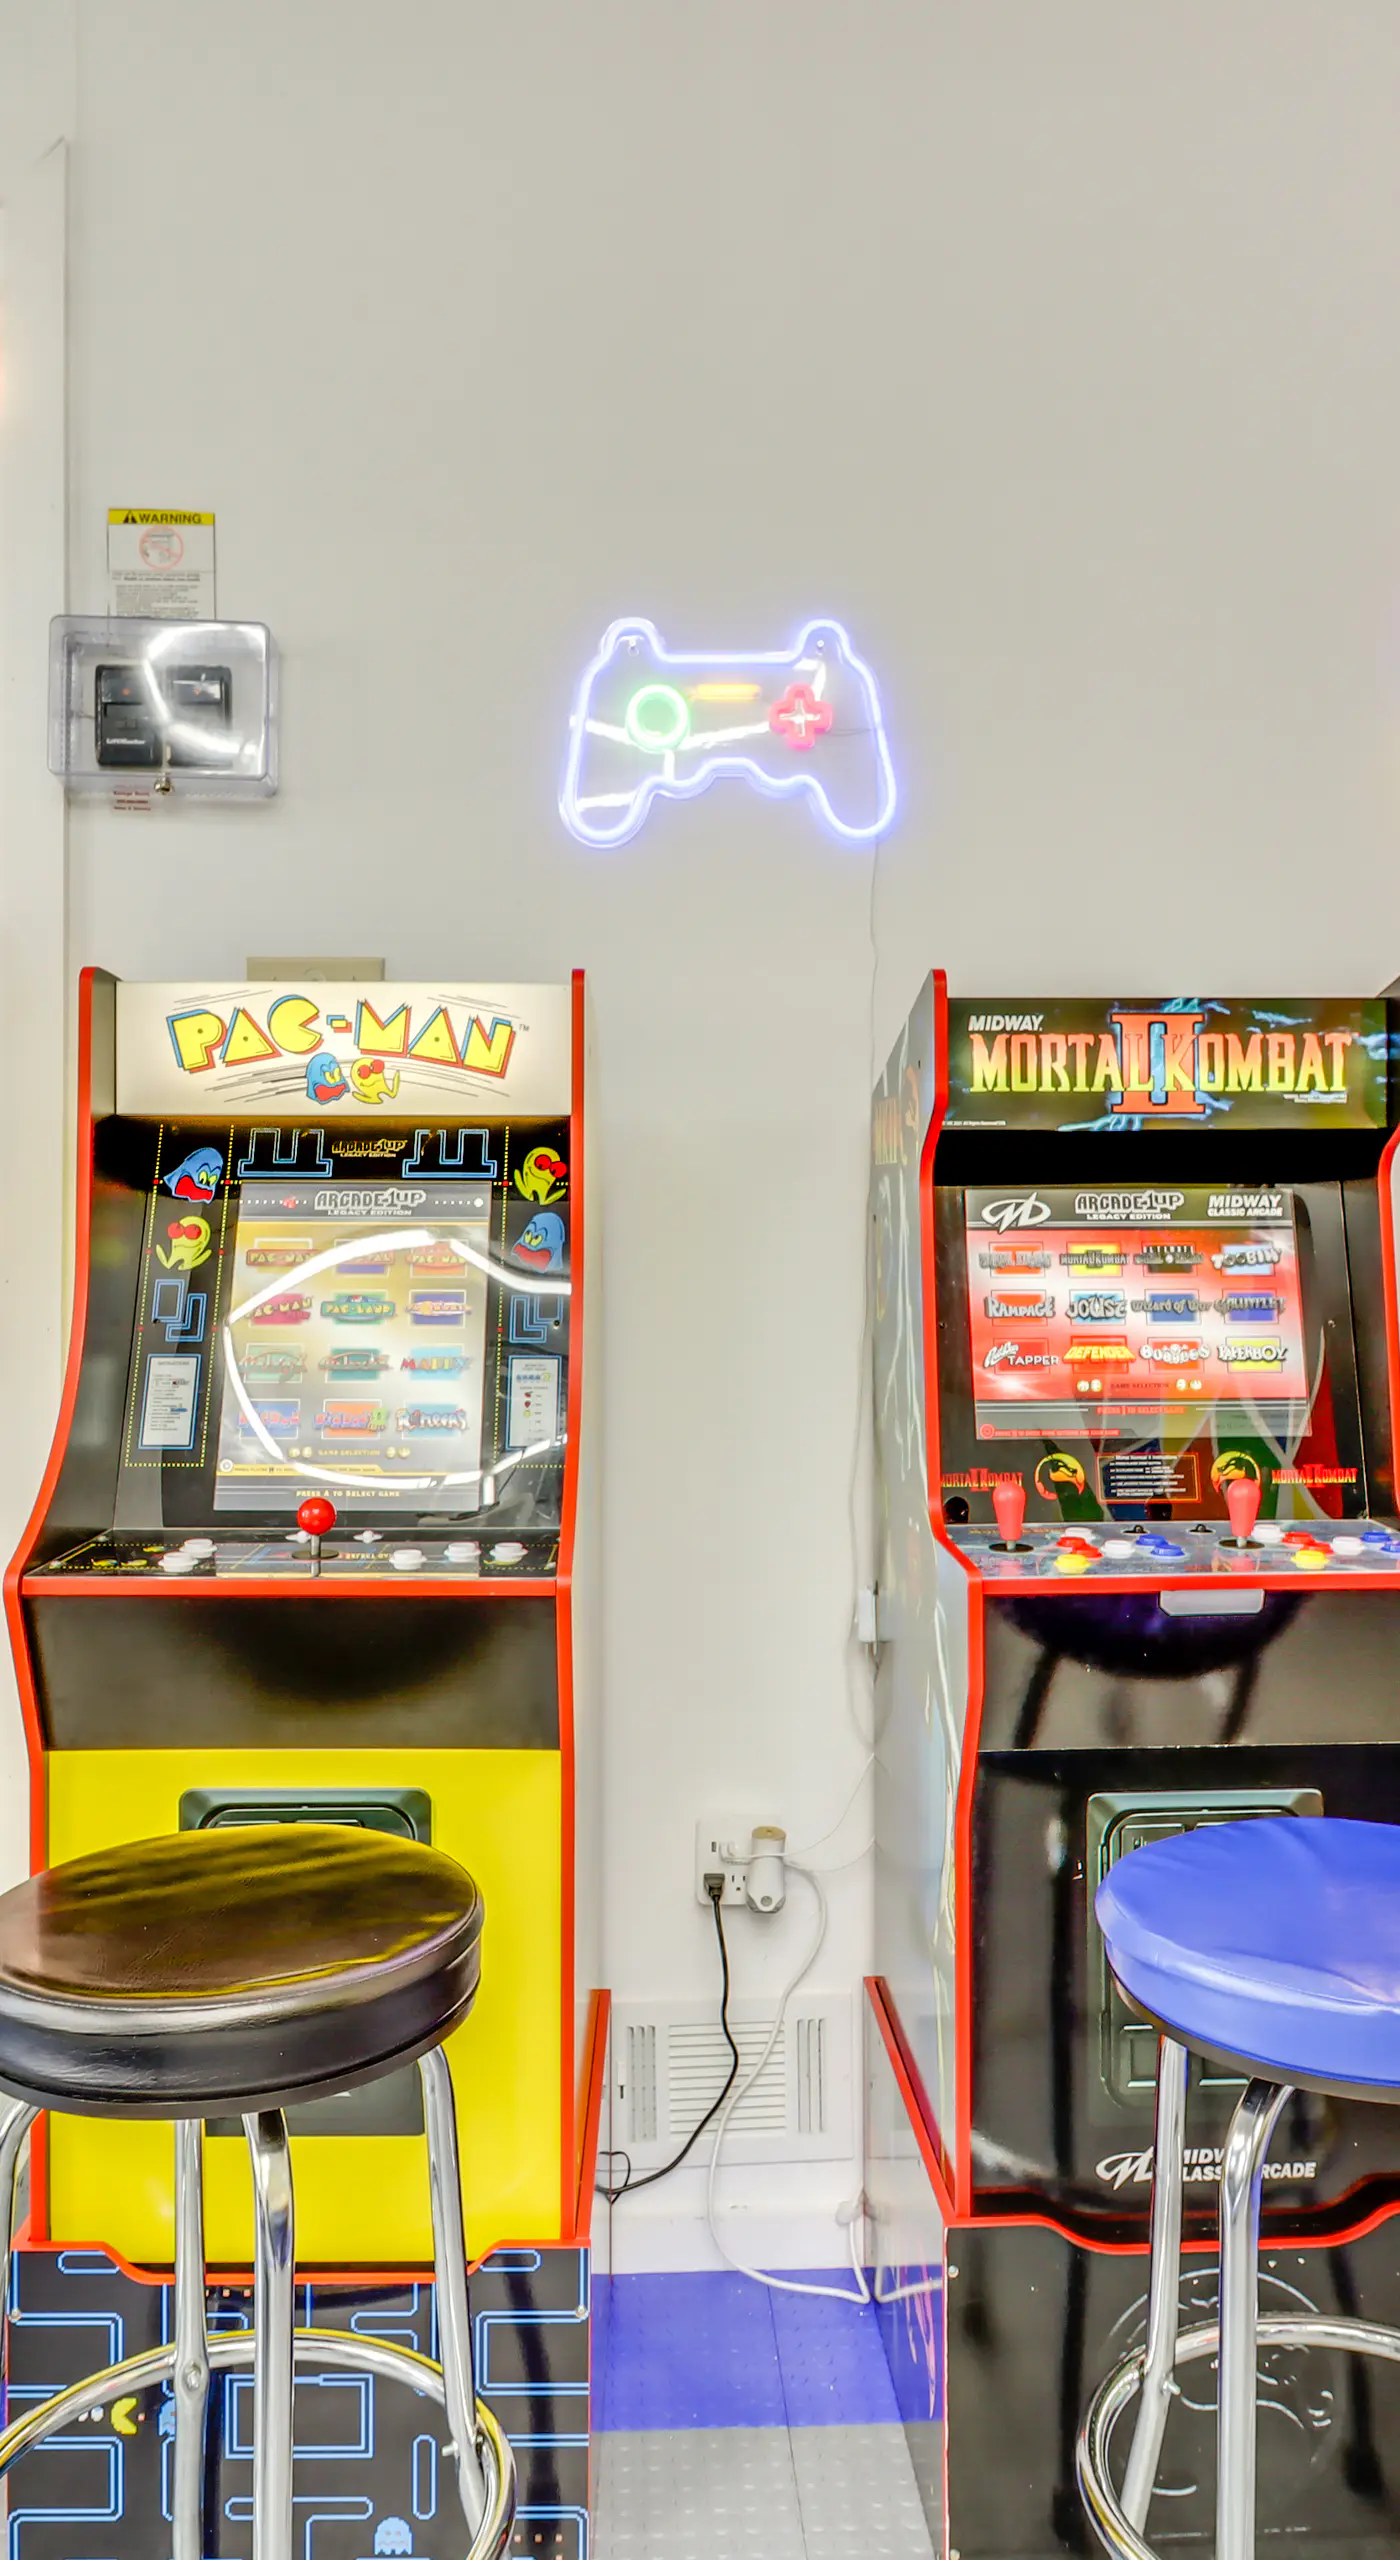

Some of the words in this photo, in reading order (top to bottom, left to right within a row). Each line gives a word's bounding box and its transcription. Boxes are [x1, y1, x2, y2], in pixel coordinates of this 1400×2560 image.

[139, 513, 202, 524] WARNING
[165, 994, 517, 1078] PAC-MAN
[969, 1033, 1155, 1093] MORTAL
[1162, 1033, 1354, 1093] KOMBAT
[1208, 1194, 1282, 1208] MIDWAY
[1086, 1213, 1127, 1221] LEGACY
[1129, 1213, 1172, 1221] EDITION
[1207, 1207, 1245, 1218] CLASSIC
[1246, 1207, 1284, 1218] ARCADE
[324, 1303, 392, 1315] PAC-LAND
[984, 1296, 1055, 1318] RAMPAGE
[1063, 1345, 1137, 1364] DEFENDER
[1217, 1343, 1288, 1362] PAPERBOY
[1008, 1354, 1060, 1366] TAPPER
[345, 1489, 376, 1497] SELECT
[1261, 2162, 1318, 2179] RCADE
